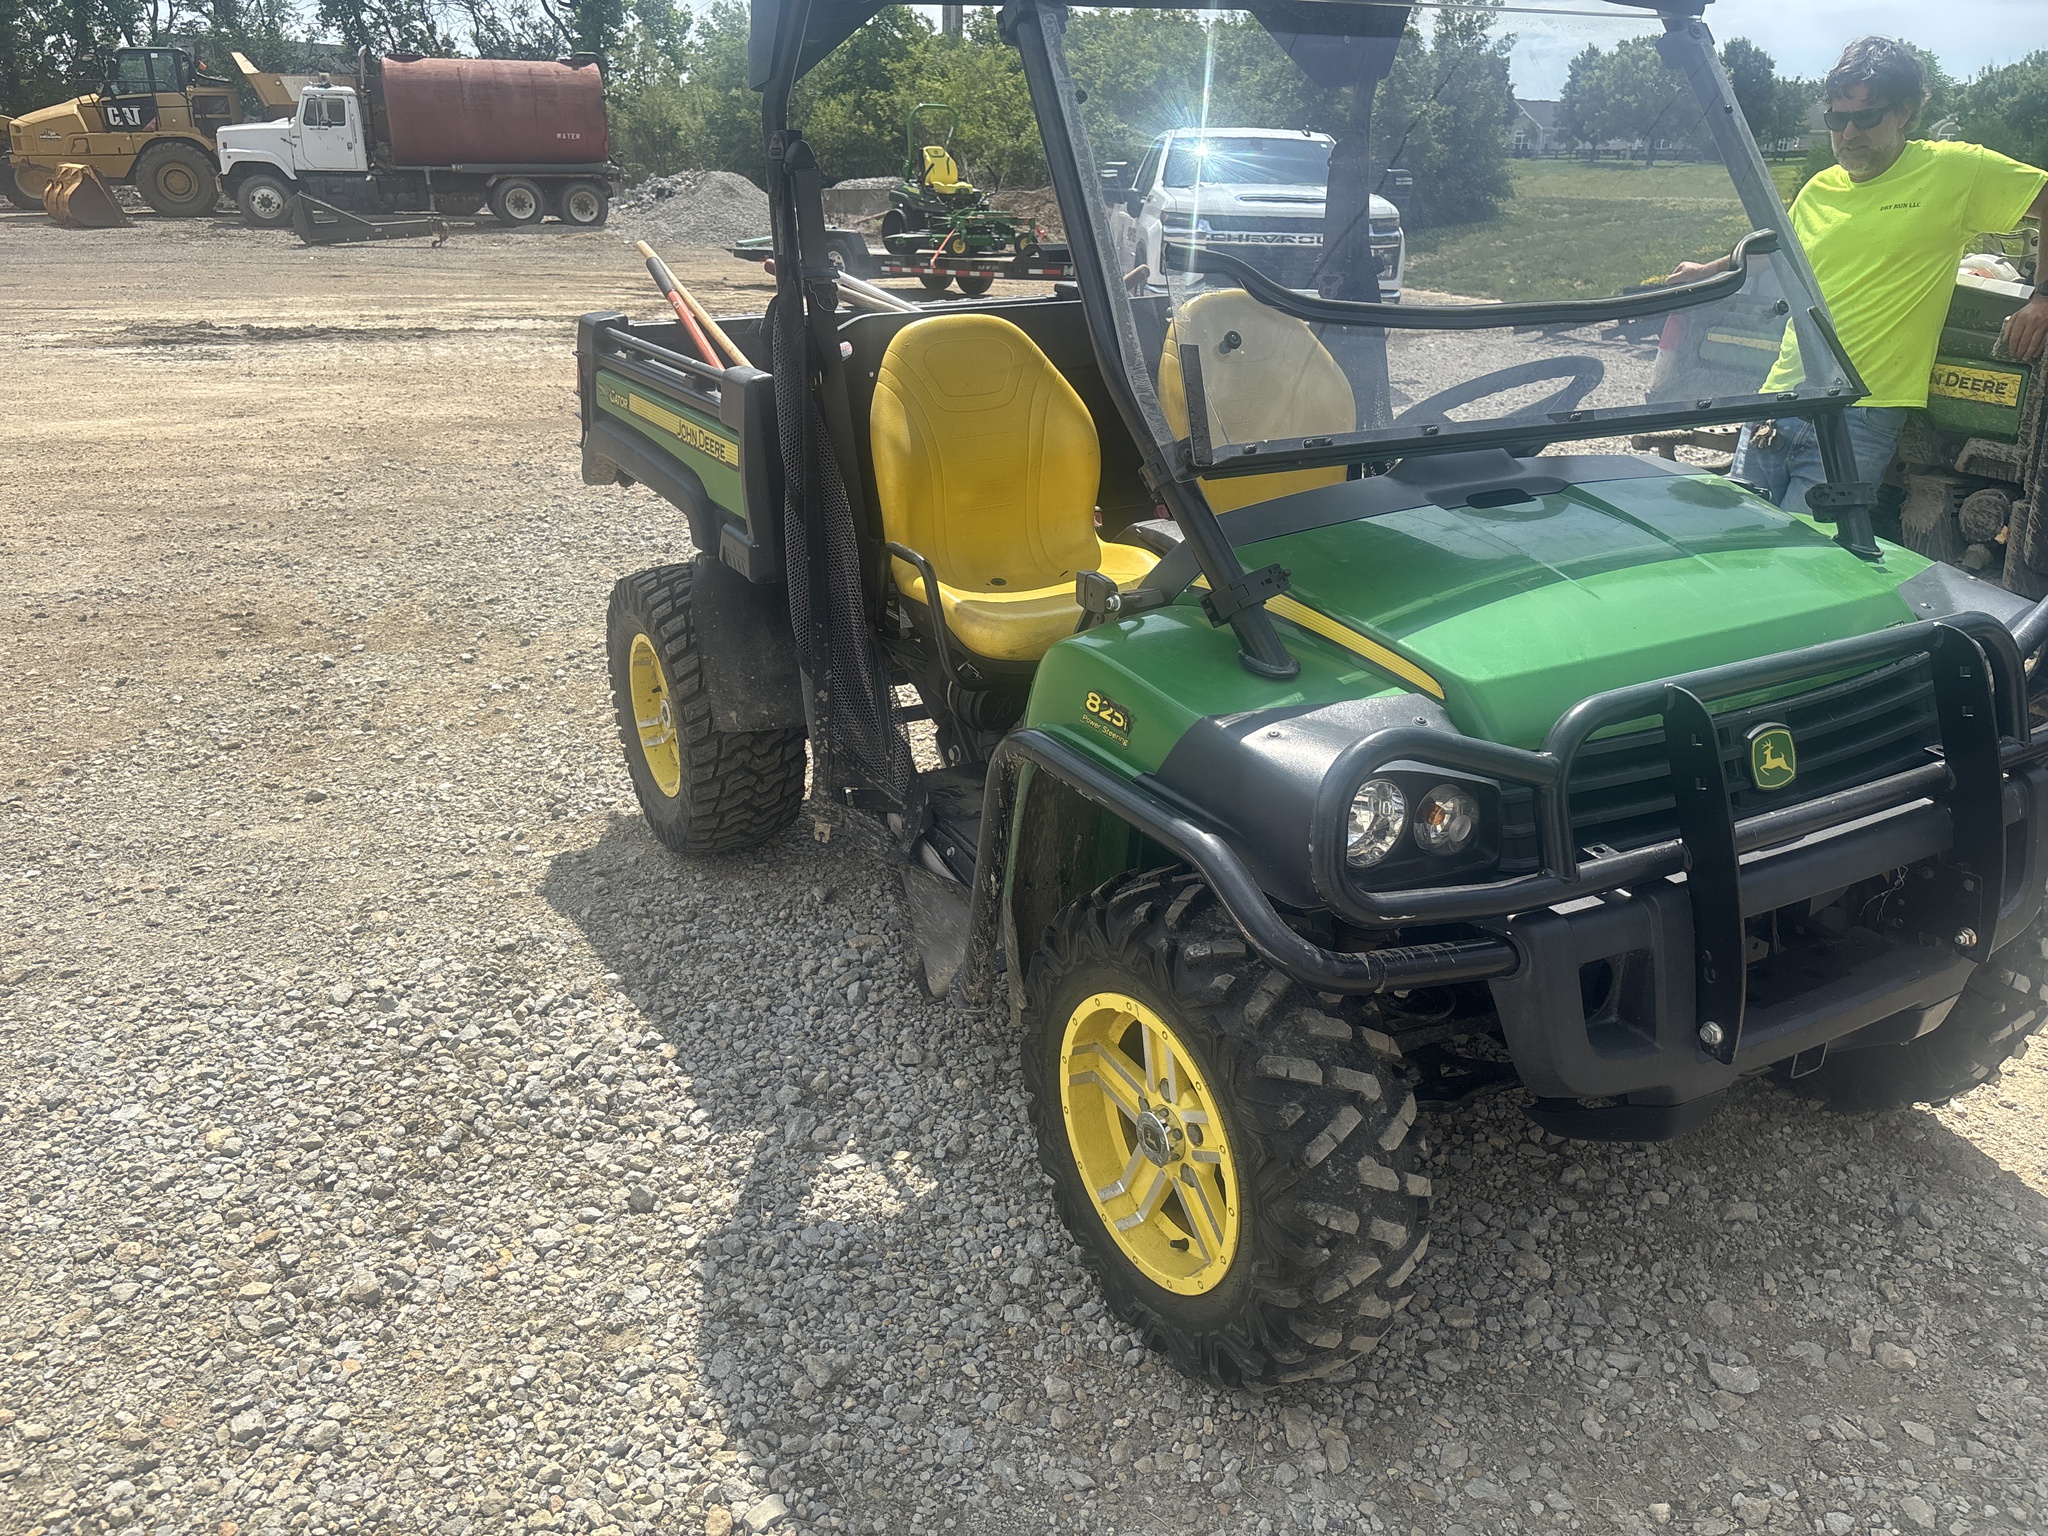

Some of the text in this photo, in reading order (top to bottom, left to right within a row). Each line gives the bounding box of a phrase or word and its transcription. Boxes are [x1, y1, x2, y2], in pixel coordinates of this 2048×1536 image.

[107, 107, 141, 126] CAT
[1209, 232, 1324, 246] CHEVROL
[1945, 372, 2008, 395] DEERE
[677, 418, 727, 462] JOHN DEERE
[1082, 713, 1129, 747] Power Steering
